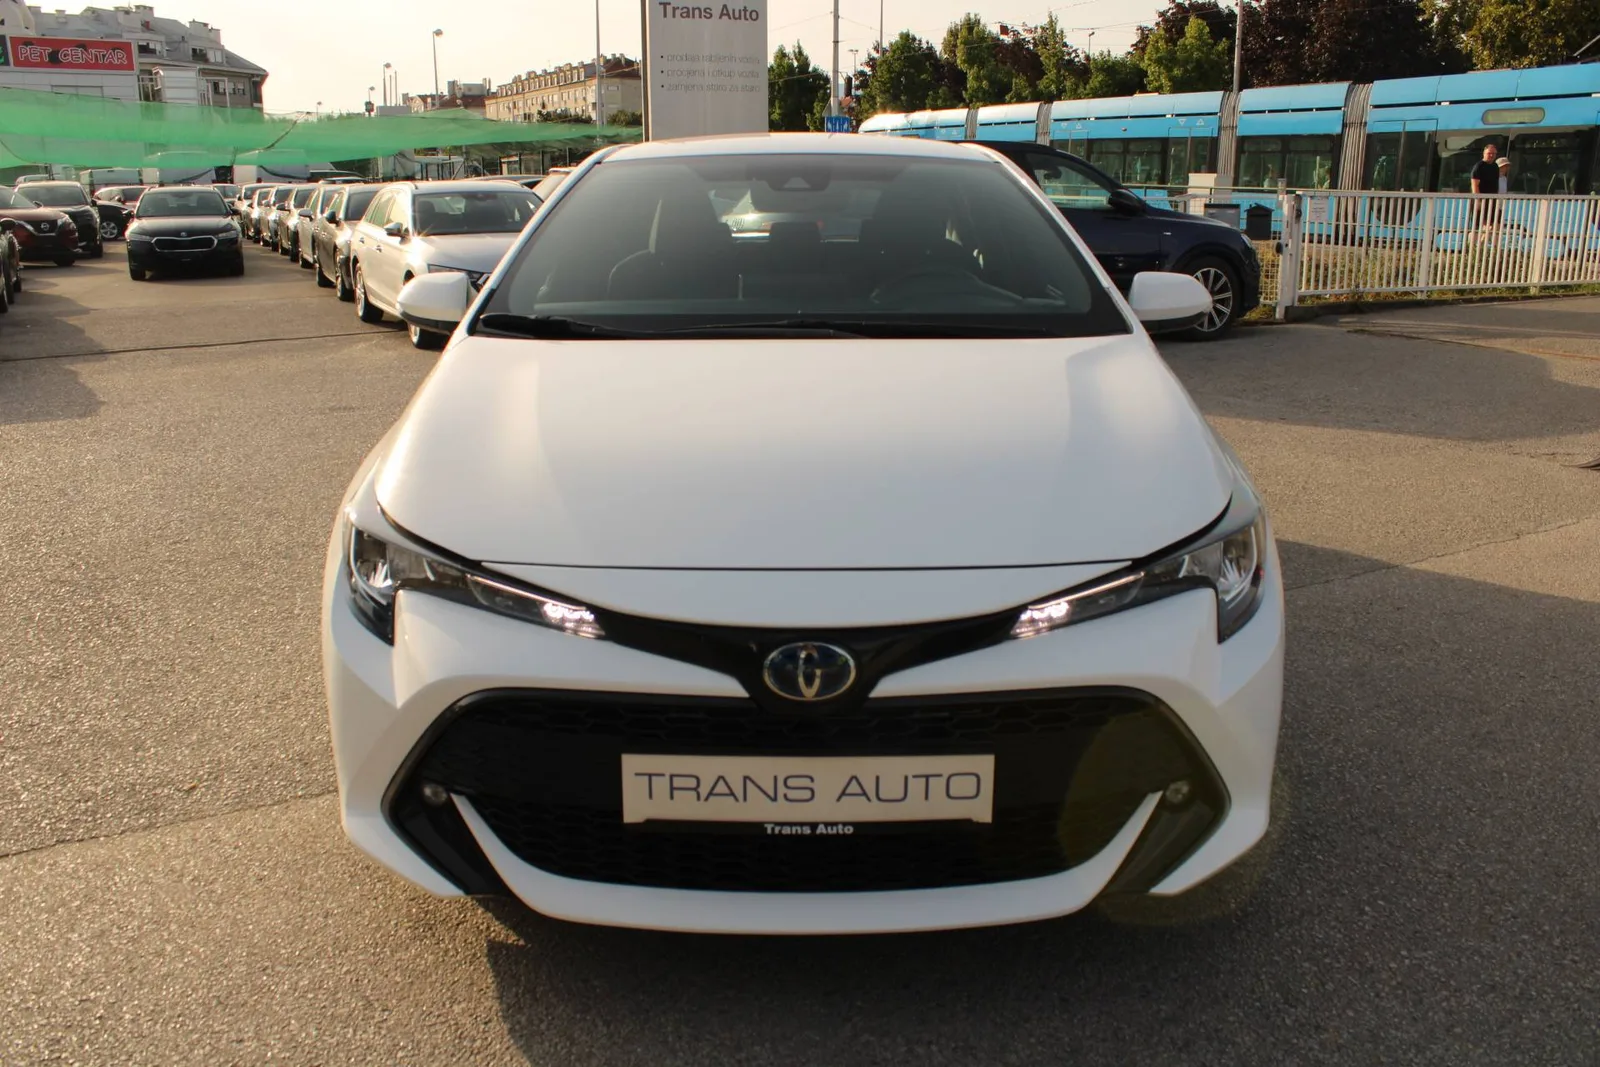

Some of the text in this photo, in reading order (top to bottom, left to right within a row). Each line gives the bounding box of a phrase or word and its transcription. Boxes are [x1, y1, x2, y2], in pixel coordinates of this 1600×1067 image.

[658, 2, 759, 22] Trans Auto
[18, 45, 128, 65] PET CENTAR
[634, 772, 982, 803] TRANS AUTO
[763, 823, 854, 835] Trans Auto
